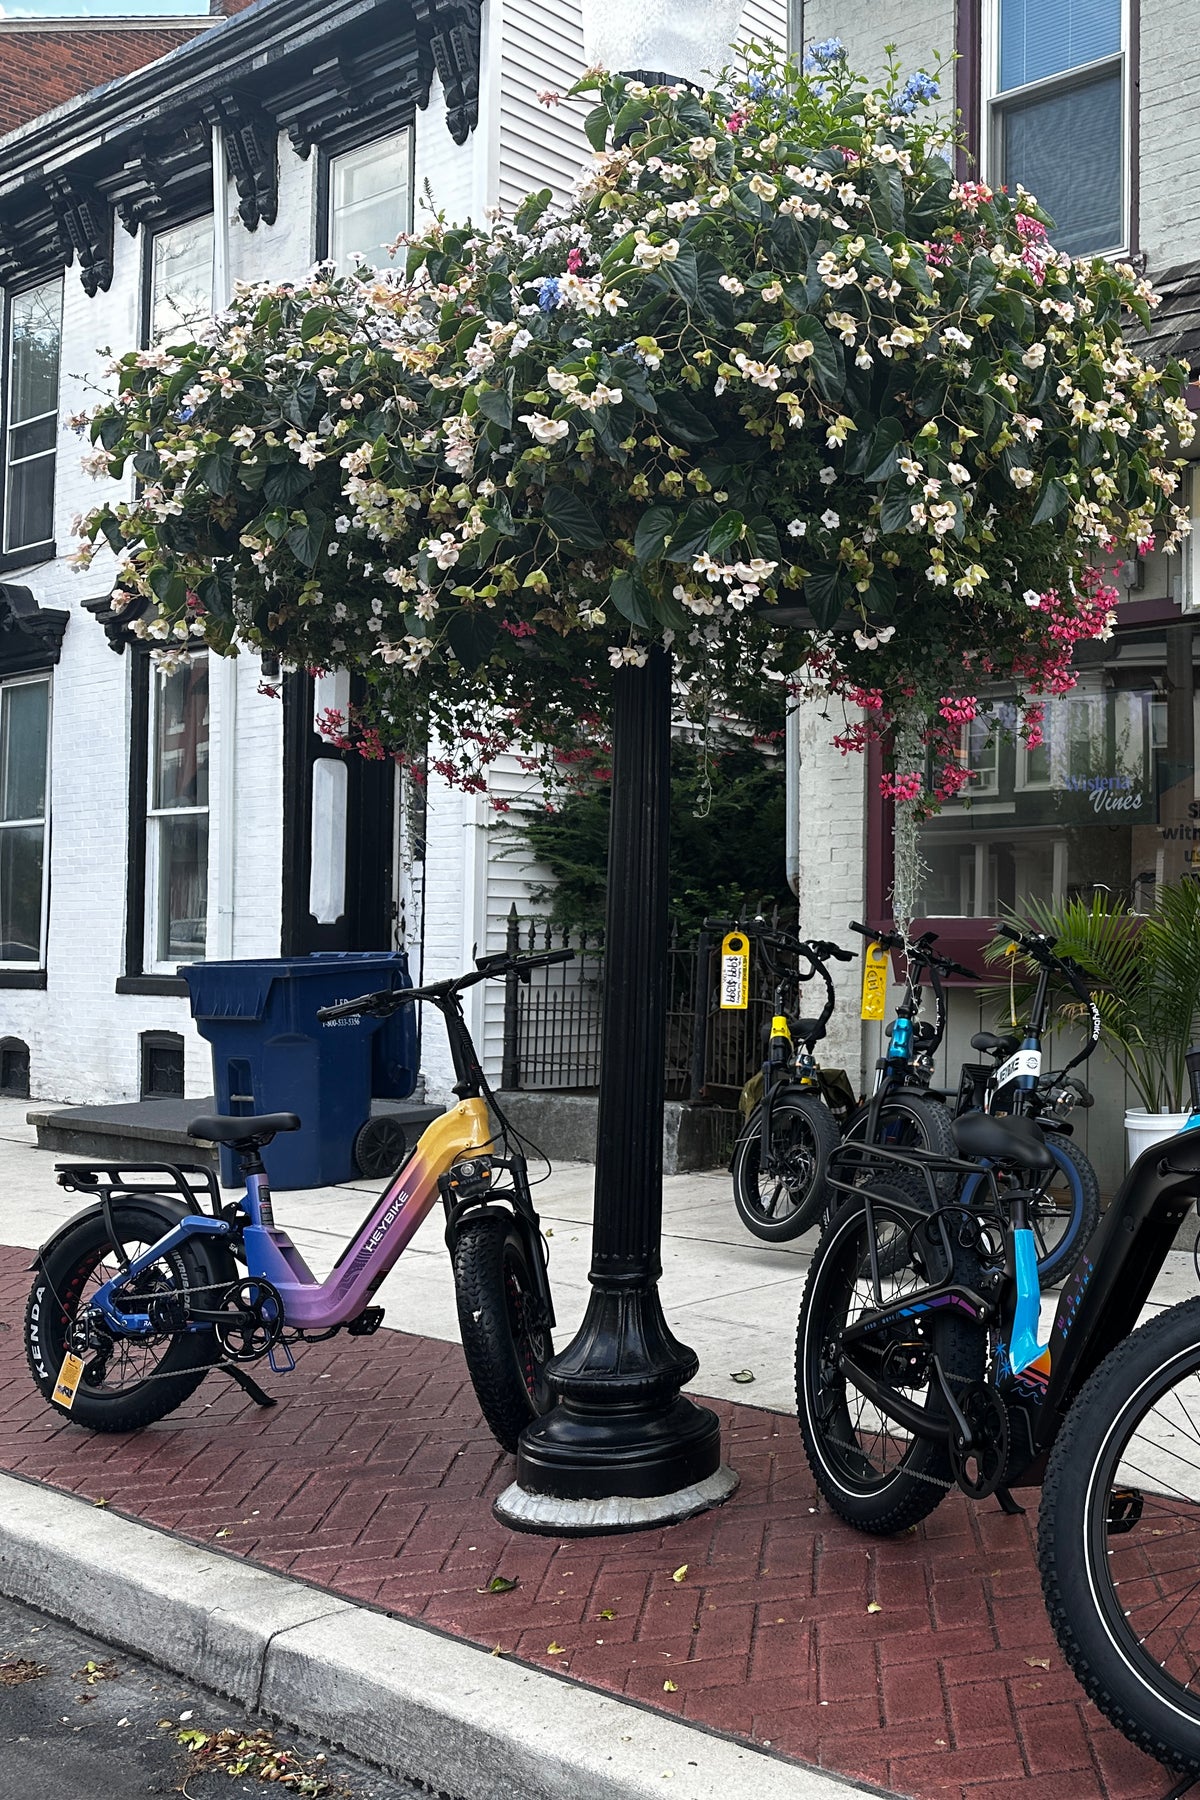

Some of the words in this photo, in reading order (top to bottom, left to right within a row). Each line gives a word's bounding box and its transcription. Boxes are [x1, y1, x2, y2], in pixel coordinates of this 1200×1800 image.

[1064, 773, 1131, 793] Wisteria
[1088, 788, 1144, 814] Vines
[365, 1190, 409, 1253] HEYBIKE
[30, 1286, 49, 1379] KENDA
